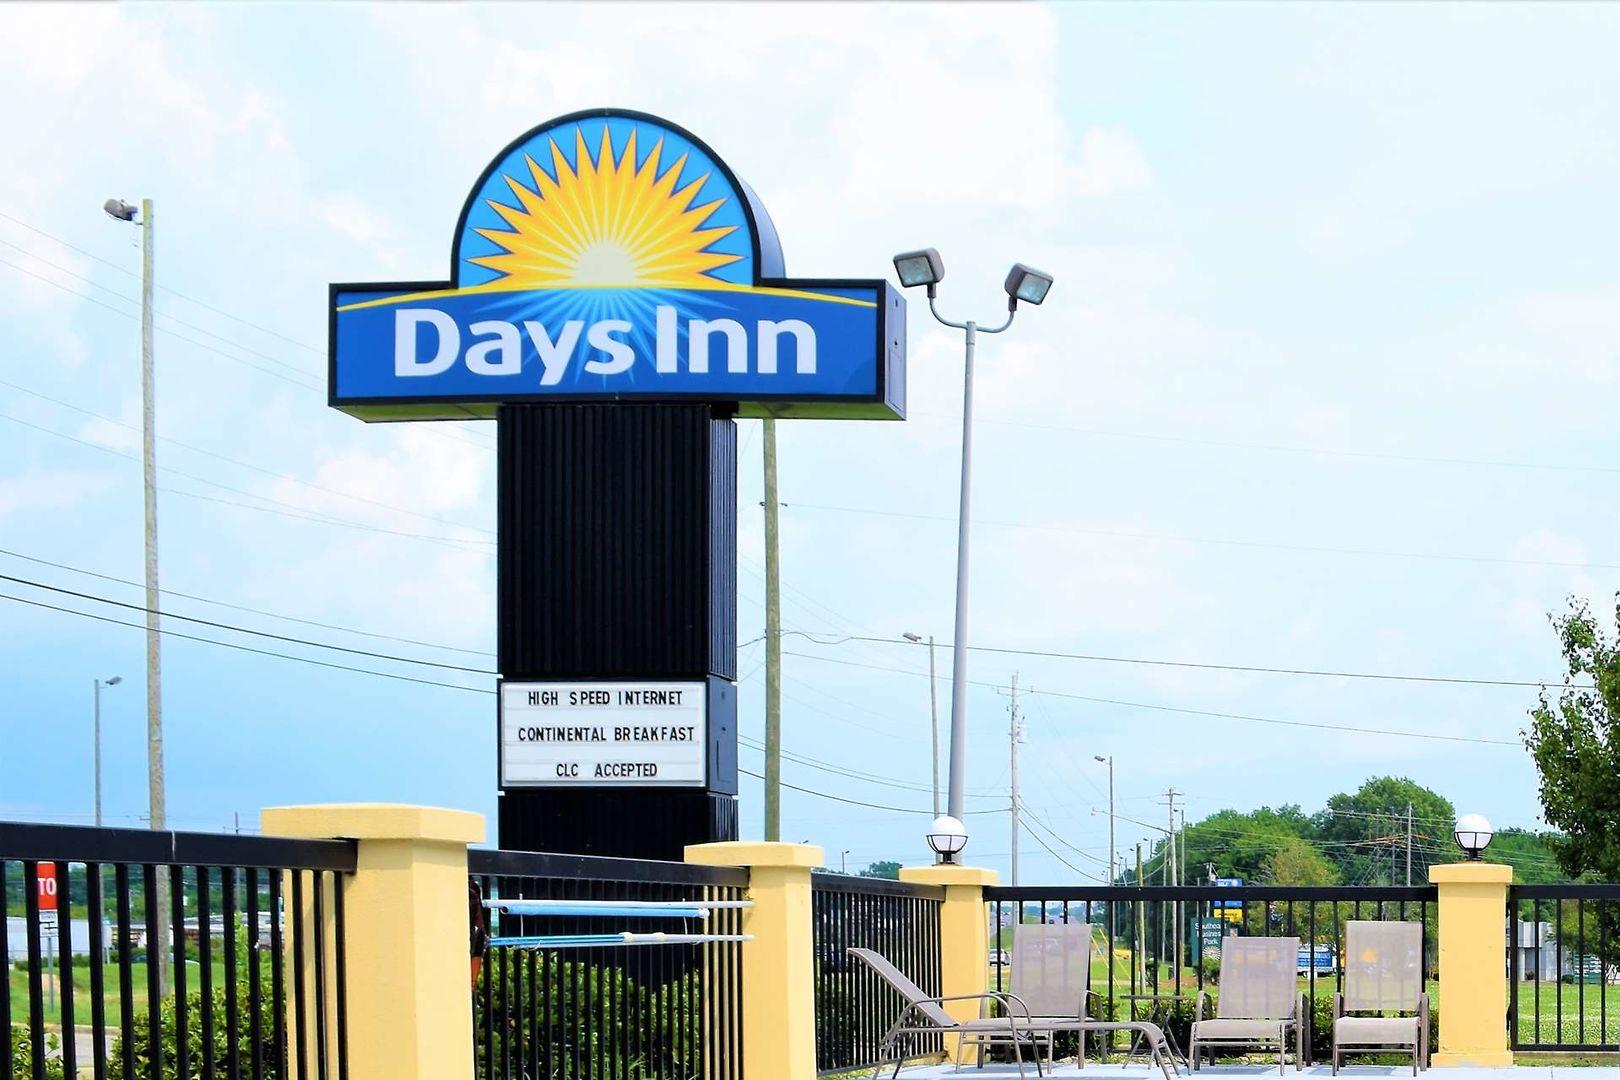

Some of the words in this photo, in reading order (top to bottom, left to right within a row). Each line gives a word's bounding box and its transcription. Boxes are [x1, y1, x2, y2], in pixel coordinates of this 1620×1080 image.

[394, 308, 636, 386] Days
[656, 306, 817, 374] Inn
[528, 690, 559, 706] HIGH
[569, 690, 611, 706] SPEED
[618, 690, 683, 706] INTERNET
[518, 727, 607, 742] CONTINENTAL
[614, 726, 695, 742] BREAKFAST
[556, 763, 579, 778] CLC
[594, 763, 658, 778] ACCEPTED
